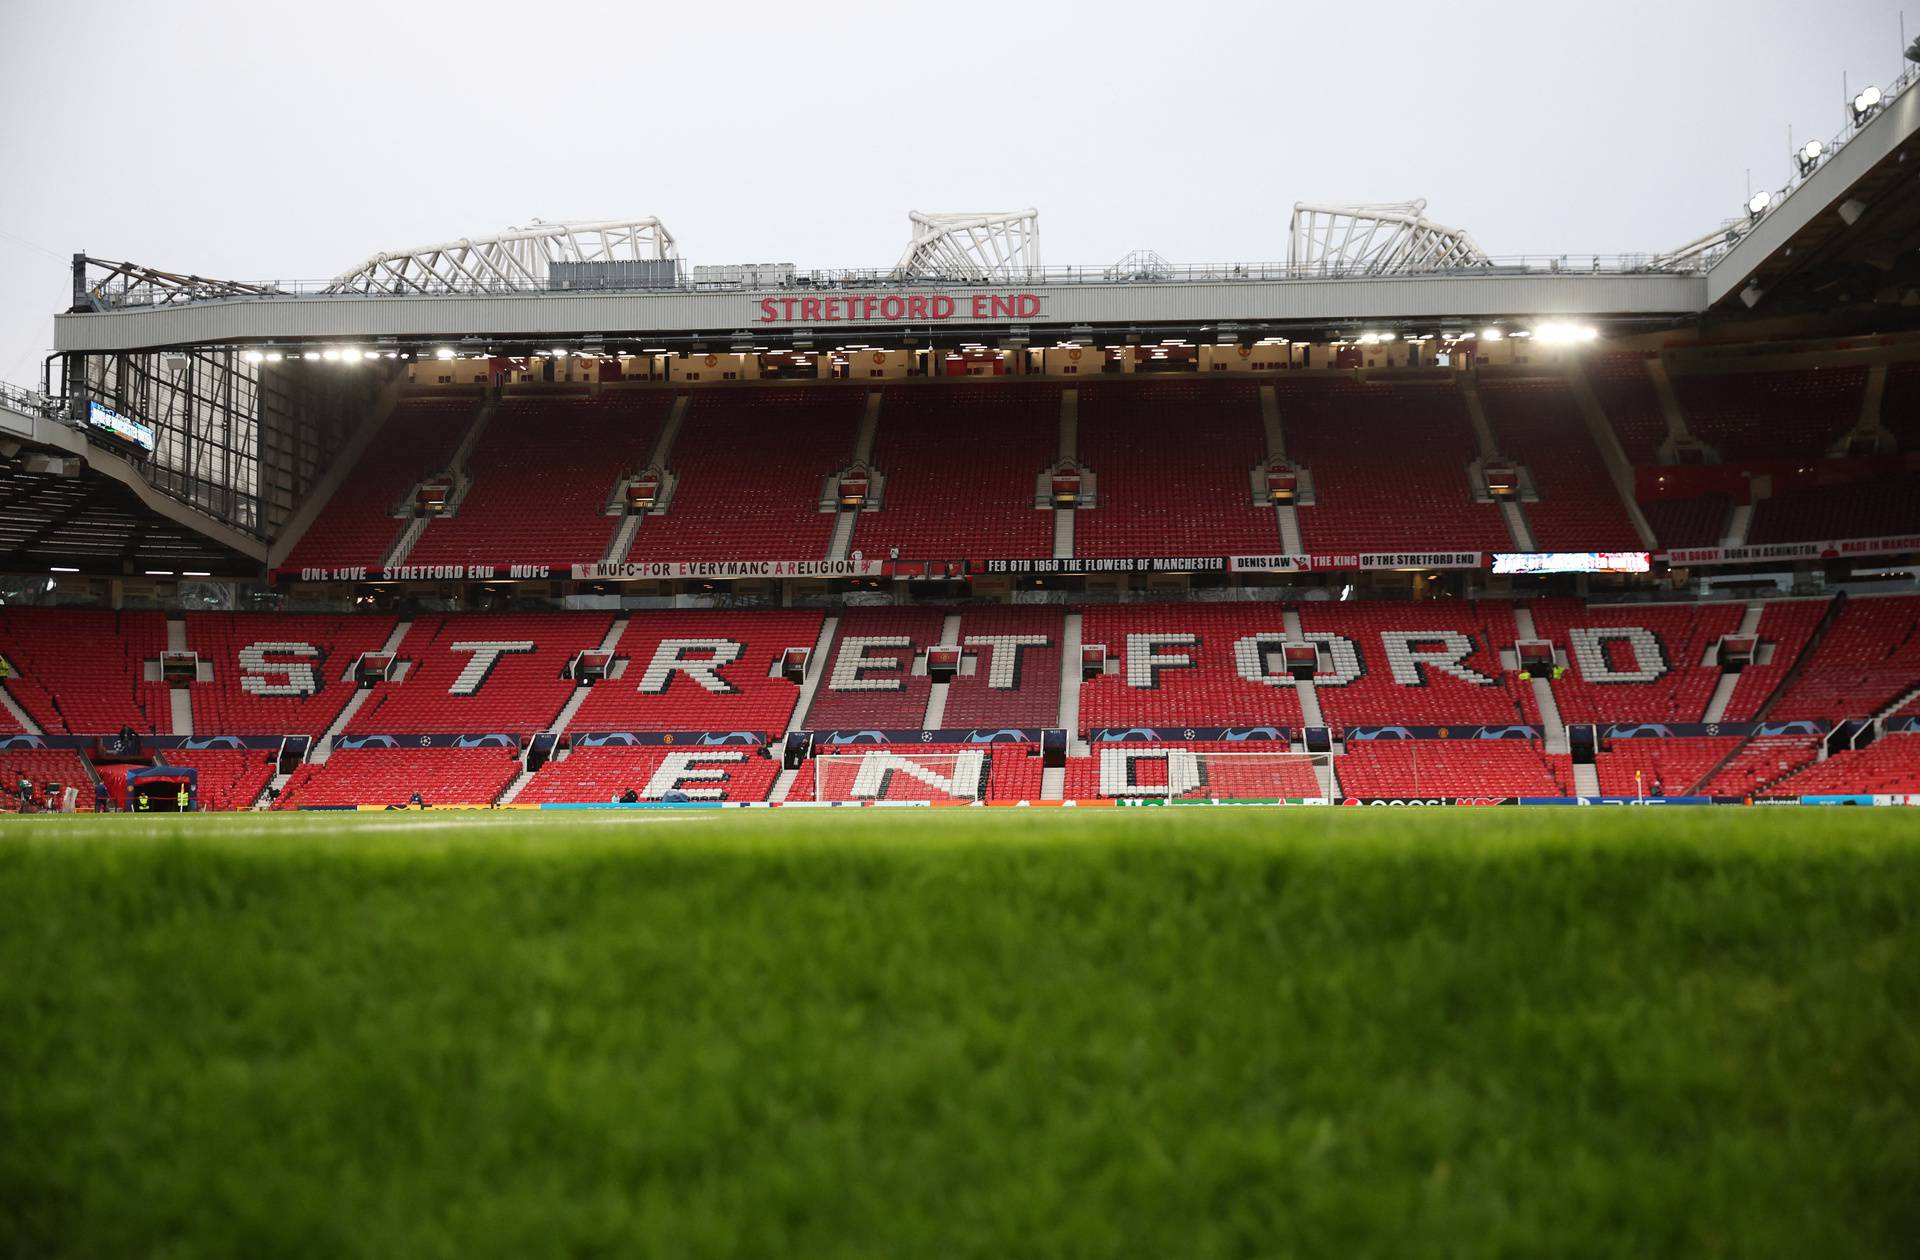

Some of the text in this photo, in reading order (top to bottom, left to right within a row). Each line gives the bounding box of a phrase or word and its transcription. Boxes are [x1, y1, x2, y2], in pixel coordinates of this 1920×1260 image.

[759, 294, 1041, 322] STRETFORD END
[775, 561, 783, 575] A
[788, 560, 855, 574] RELIGION
[988, 557, 1223, 572] FEB 6TH 1958 THE FLOWERS OF MANCHESTER
[1238, 554, 1474, 568] DENIS LAW THE KING OF THE STRETFORD END
[301, 564, 549, 580] ONE LOVE STRETFORD END MUFC
